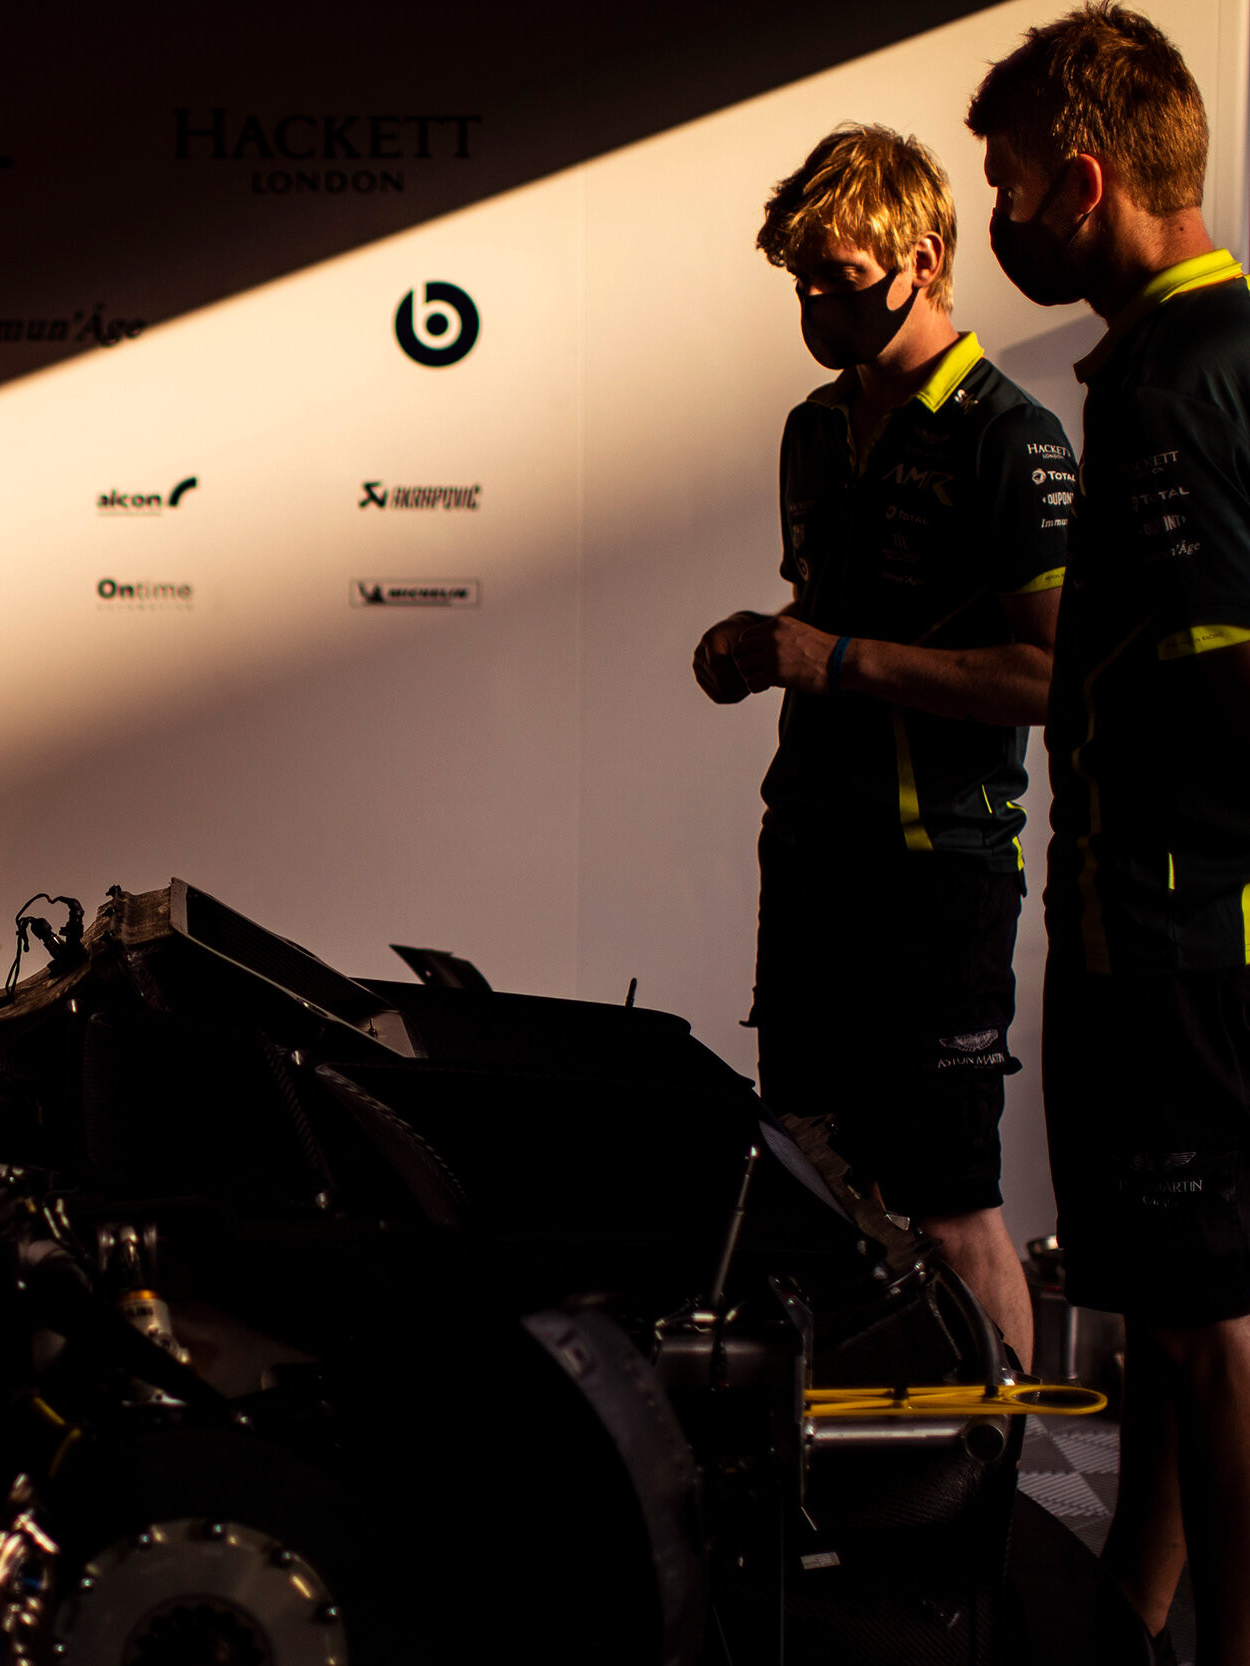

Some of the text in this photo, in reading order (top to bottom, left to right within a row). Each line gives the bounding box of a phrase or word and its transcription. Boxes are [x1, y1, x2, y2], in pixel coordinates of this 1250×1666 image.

[174, 108, 483, 159] HACKETT
[251, 171, 405, 194] LONDON
[1047, 470, 1077, 482] TOTAL
[96, 488, 163, 509] alcon
[97, 578, 192, 600] Ontime
